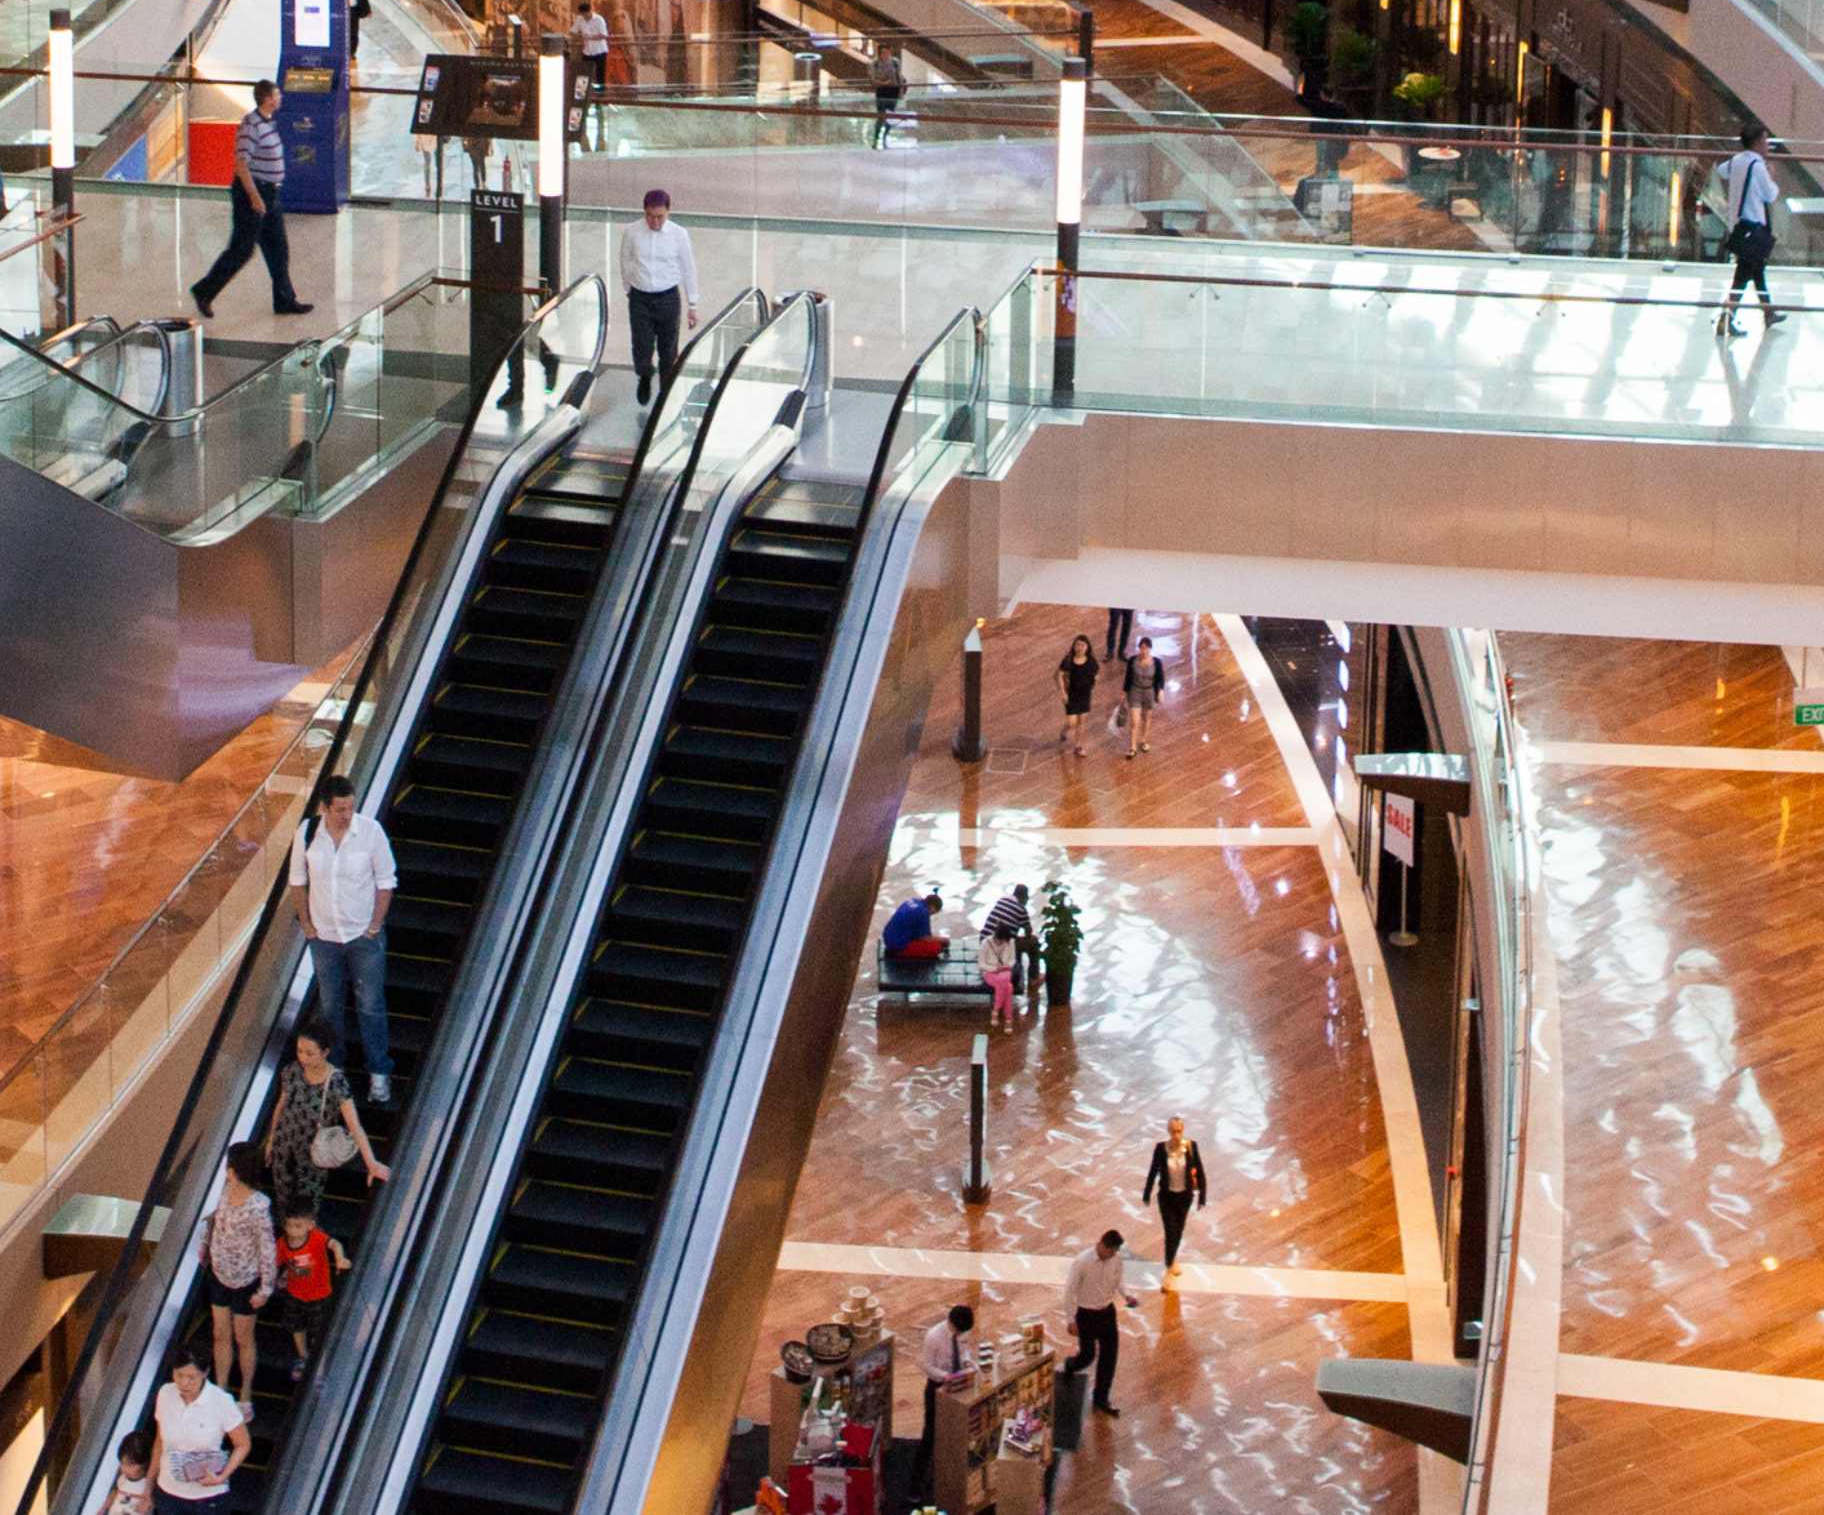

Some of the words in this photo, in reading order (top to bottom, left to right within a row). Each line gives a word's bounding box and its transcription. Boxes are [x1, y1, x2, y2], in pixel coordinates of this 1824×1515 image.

[475, 194, 518, 208] LEVEL
[490, 215, 503, 243] 1
[1387, 803, 1412, 839] SALE
